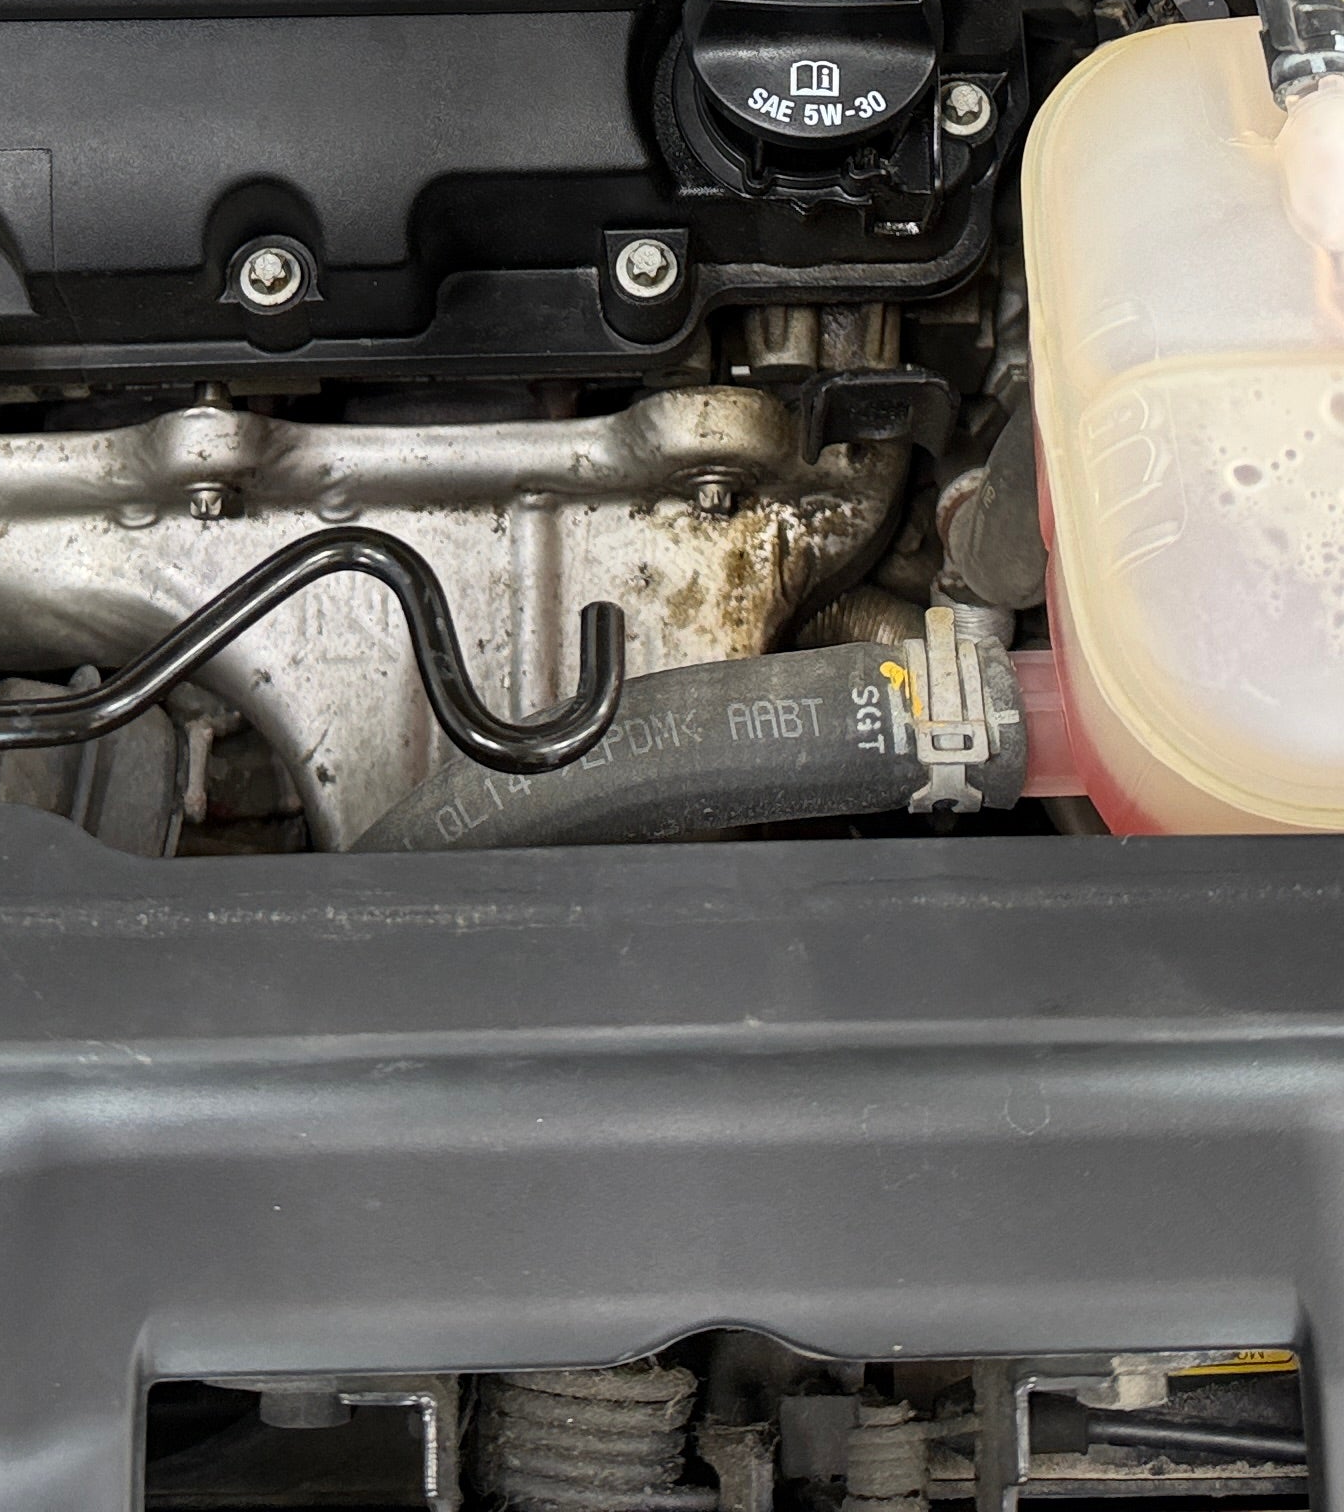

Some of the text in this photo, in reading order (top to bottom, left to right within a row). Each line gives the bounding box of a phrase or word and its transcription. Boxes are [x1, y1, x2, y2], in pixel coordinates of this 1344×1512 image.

[747, 87, 888, 126] SAE 5W-30
[728, 697, 825, 740] AABT
[851, 684, 887, 756] SGT
